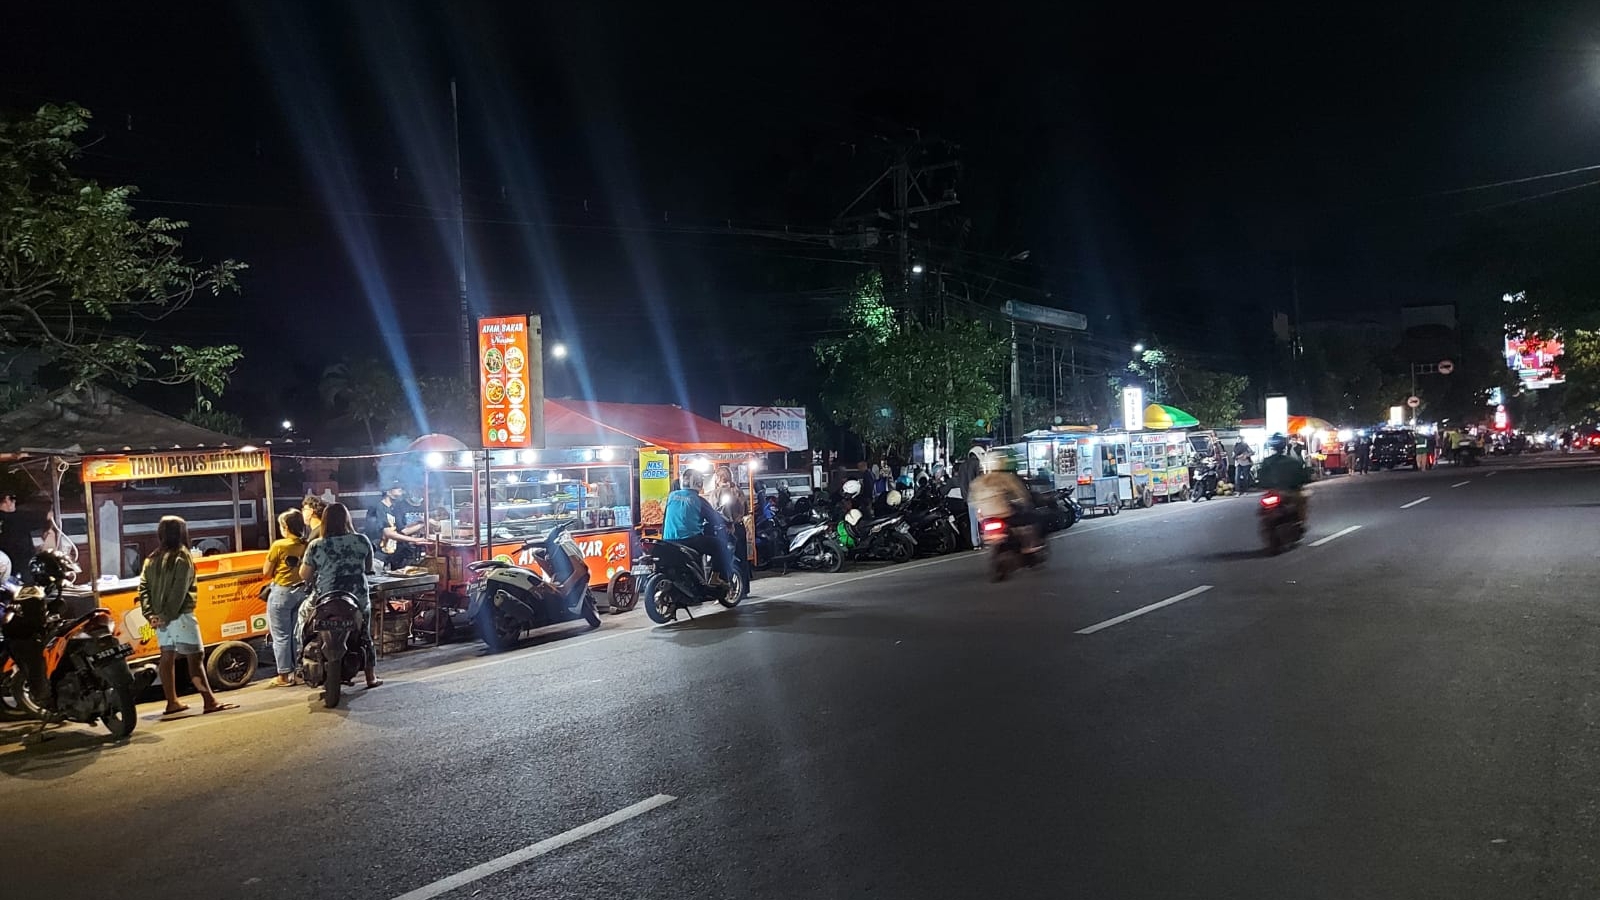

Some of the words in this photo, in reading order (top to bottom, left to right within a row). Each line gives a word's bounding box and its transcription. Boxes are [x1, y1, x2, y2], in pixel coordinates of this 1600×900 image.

[482, 324, 500, 333] AYAM
[501, 322, 524, 332] BAKAR
[760, 420, 800, 430] DISPENSER
[130, 457, 165, 475] TAHU
[167, 454, 207, 474] PEDES
[642, 470, 668, 479] GORENG
